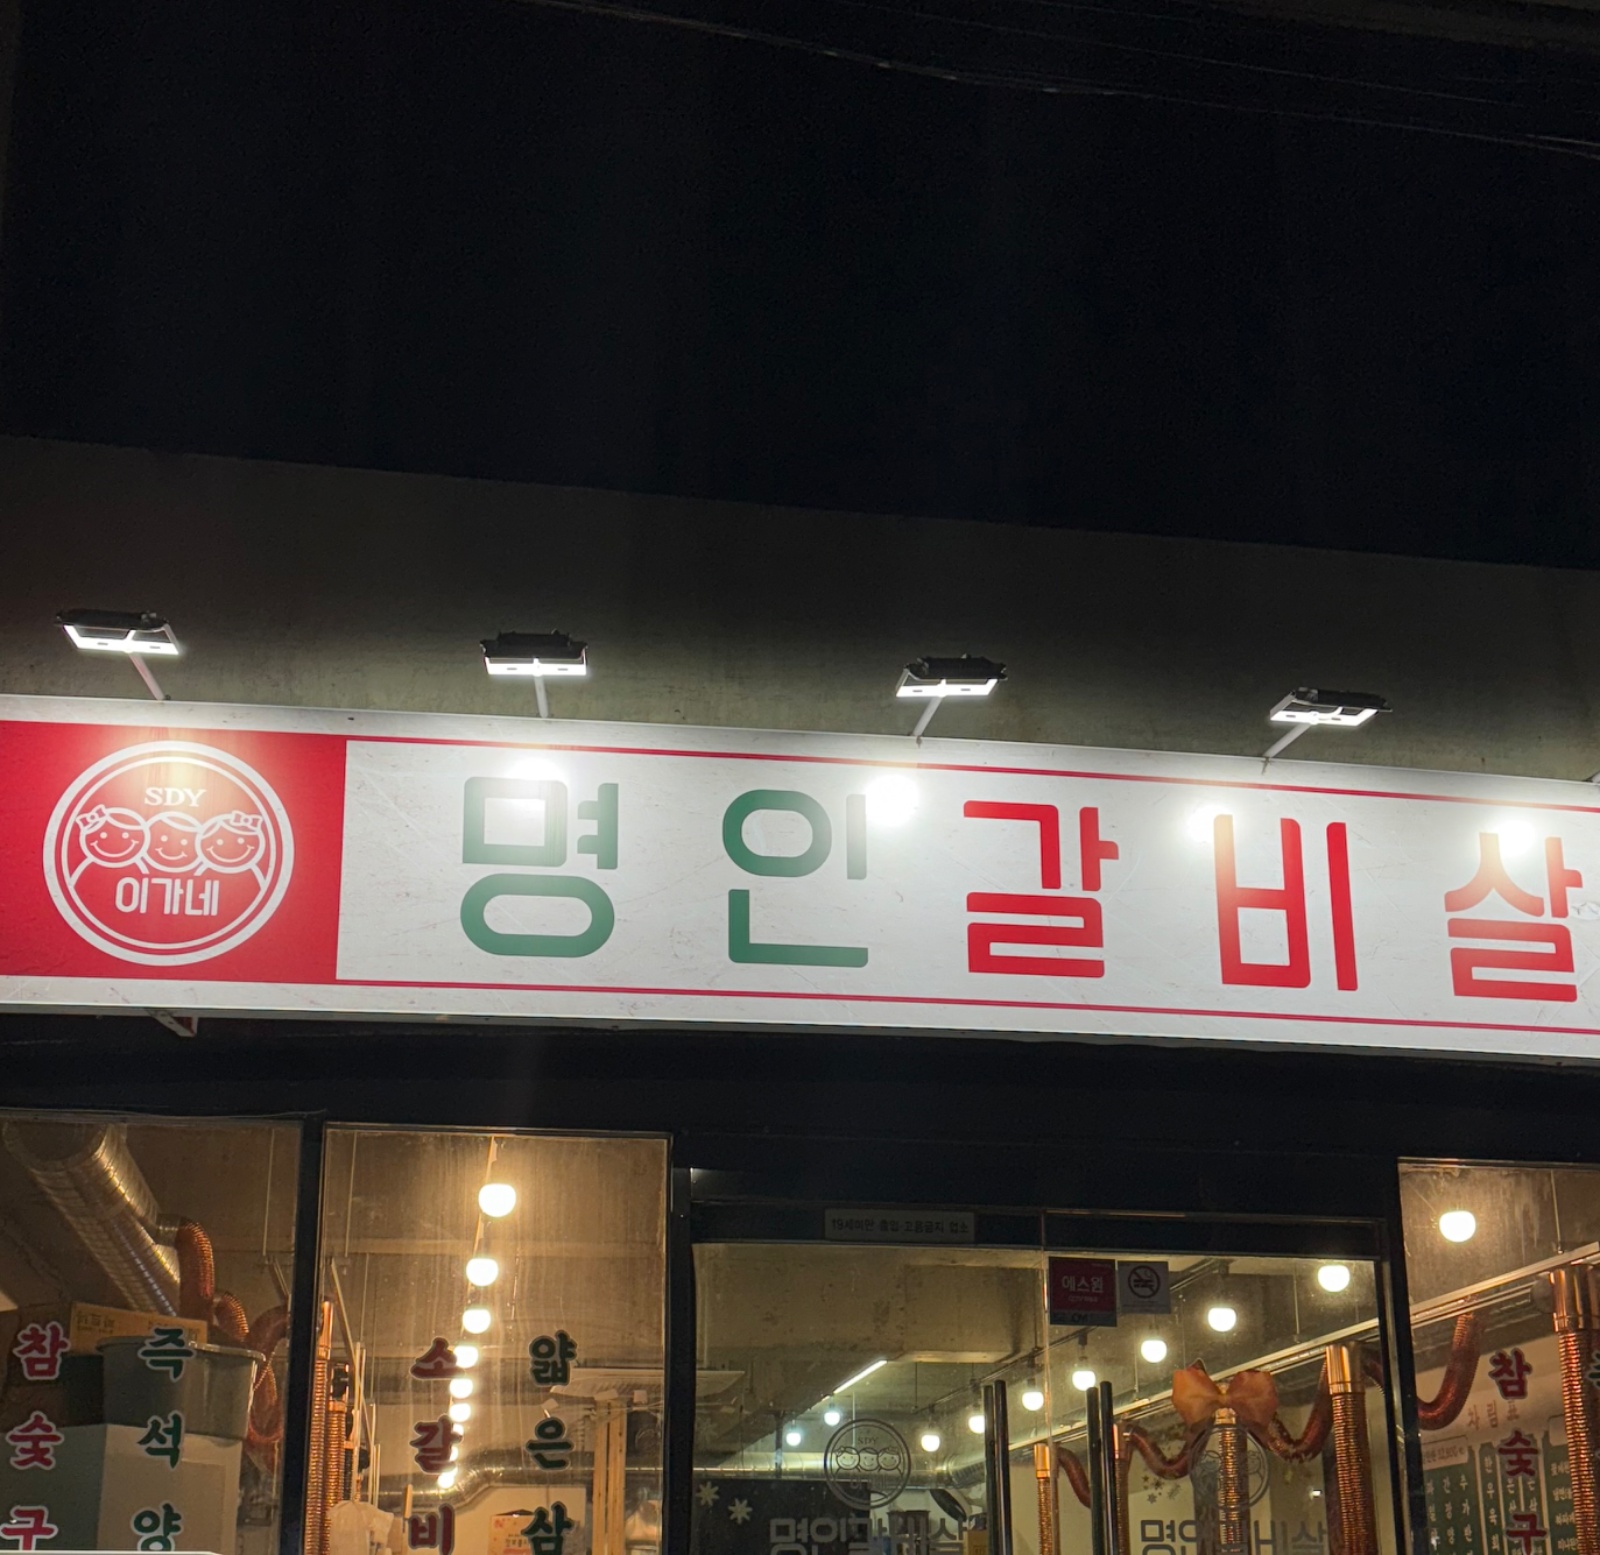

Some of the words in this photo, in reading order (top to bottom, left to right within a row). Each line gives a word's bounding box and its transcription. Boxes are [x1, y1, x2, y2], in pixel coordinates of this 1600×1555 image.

[144, 786, 207, 808] SDY
[116, 876, 219, 916] 이가네
[1062, 1274, 1105, 1294] 에스원
